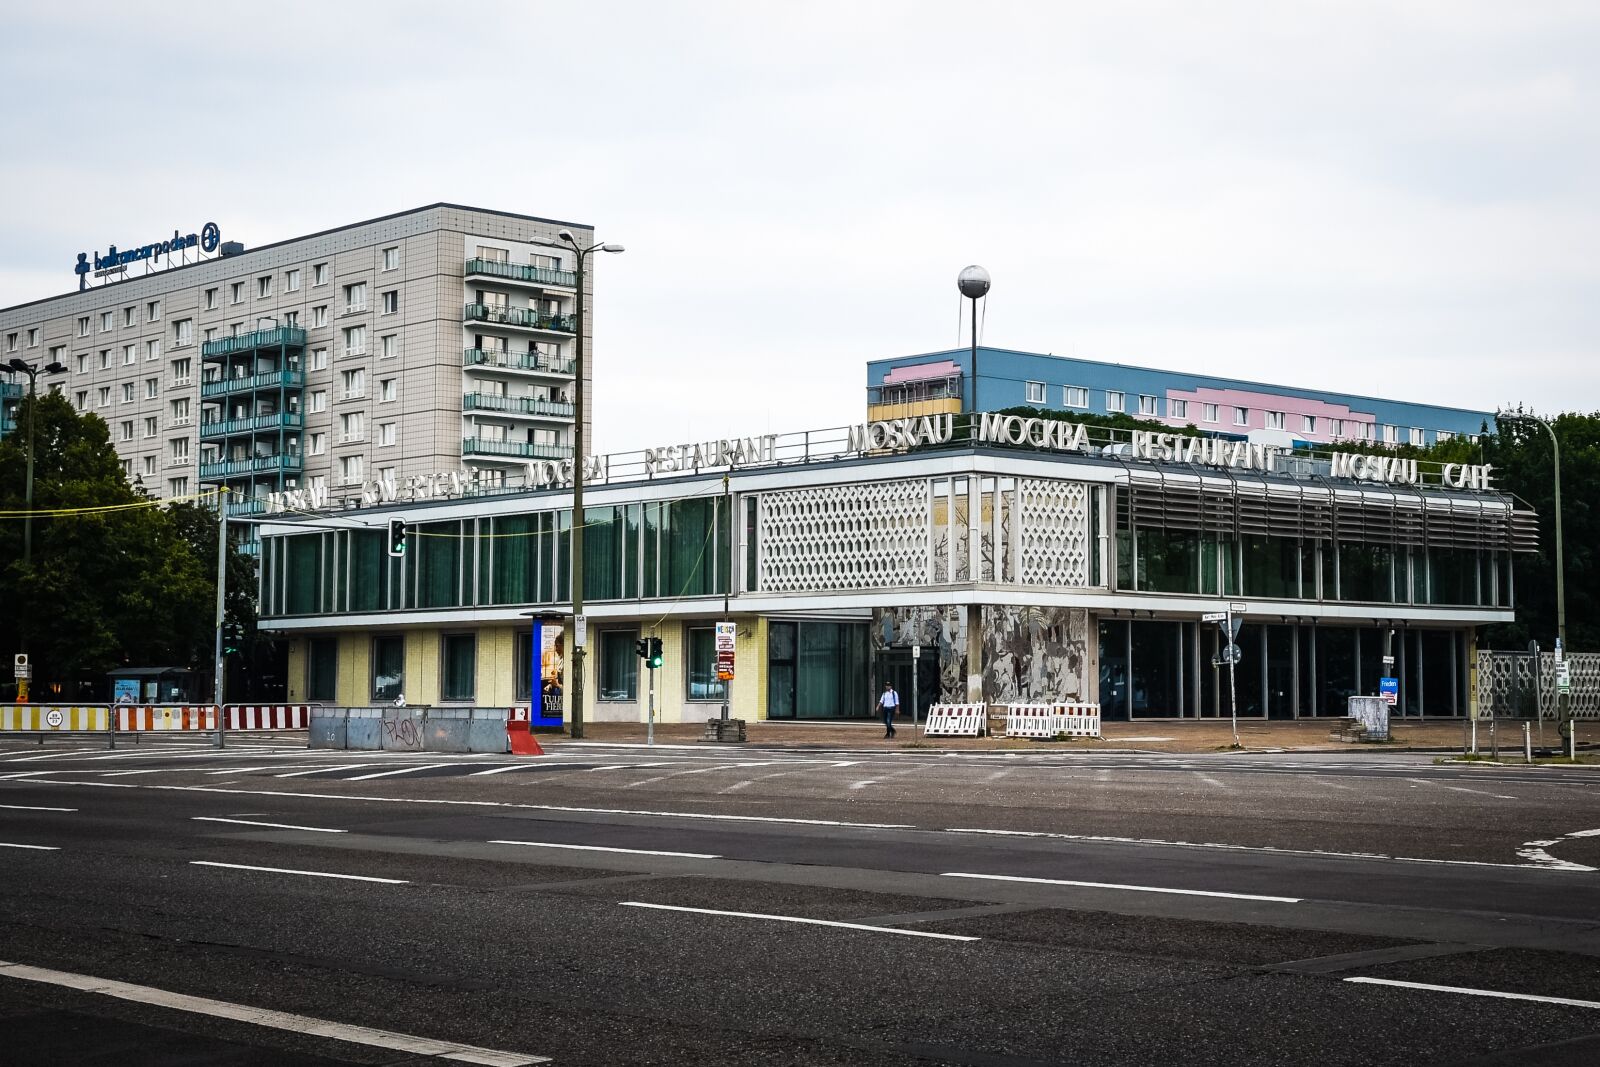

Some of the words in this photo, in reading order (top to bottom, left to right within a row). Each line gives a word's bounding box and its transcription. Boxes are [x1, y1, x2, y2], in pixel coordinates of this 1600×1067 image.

[645, 434, 778, 474] RESTAURANT
[847, 413, 952, 452] MOSKAU
[1132, 429, 1279, 471] RESTAURANT
[1331, 452, 1417, 484] MOSKAU
[265, 485, 328, 514] MOSKAU
